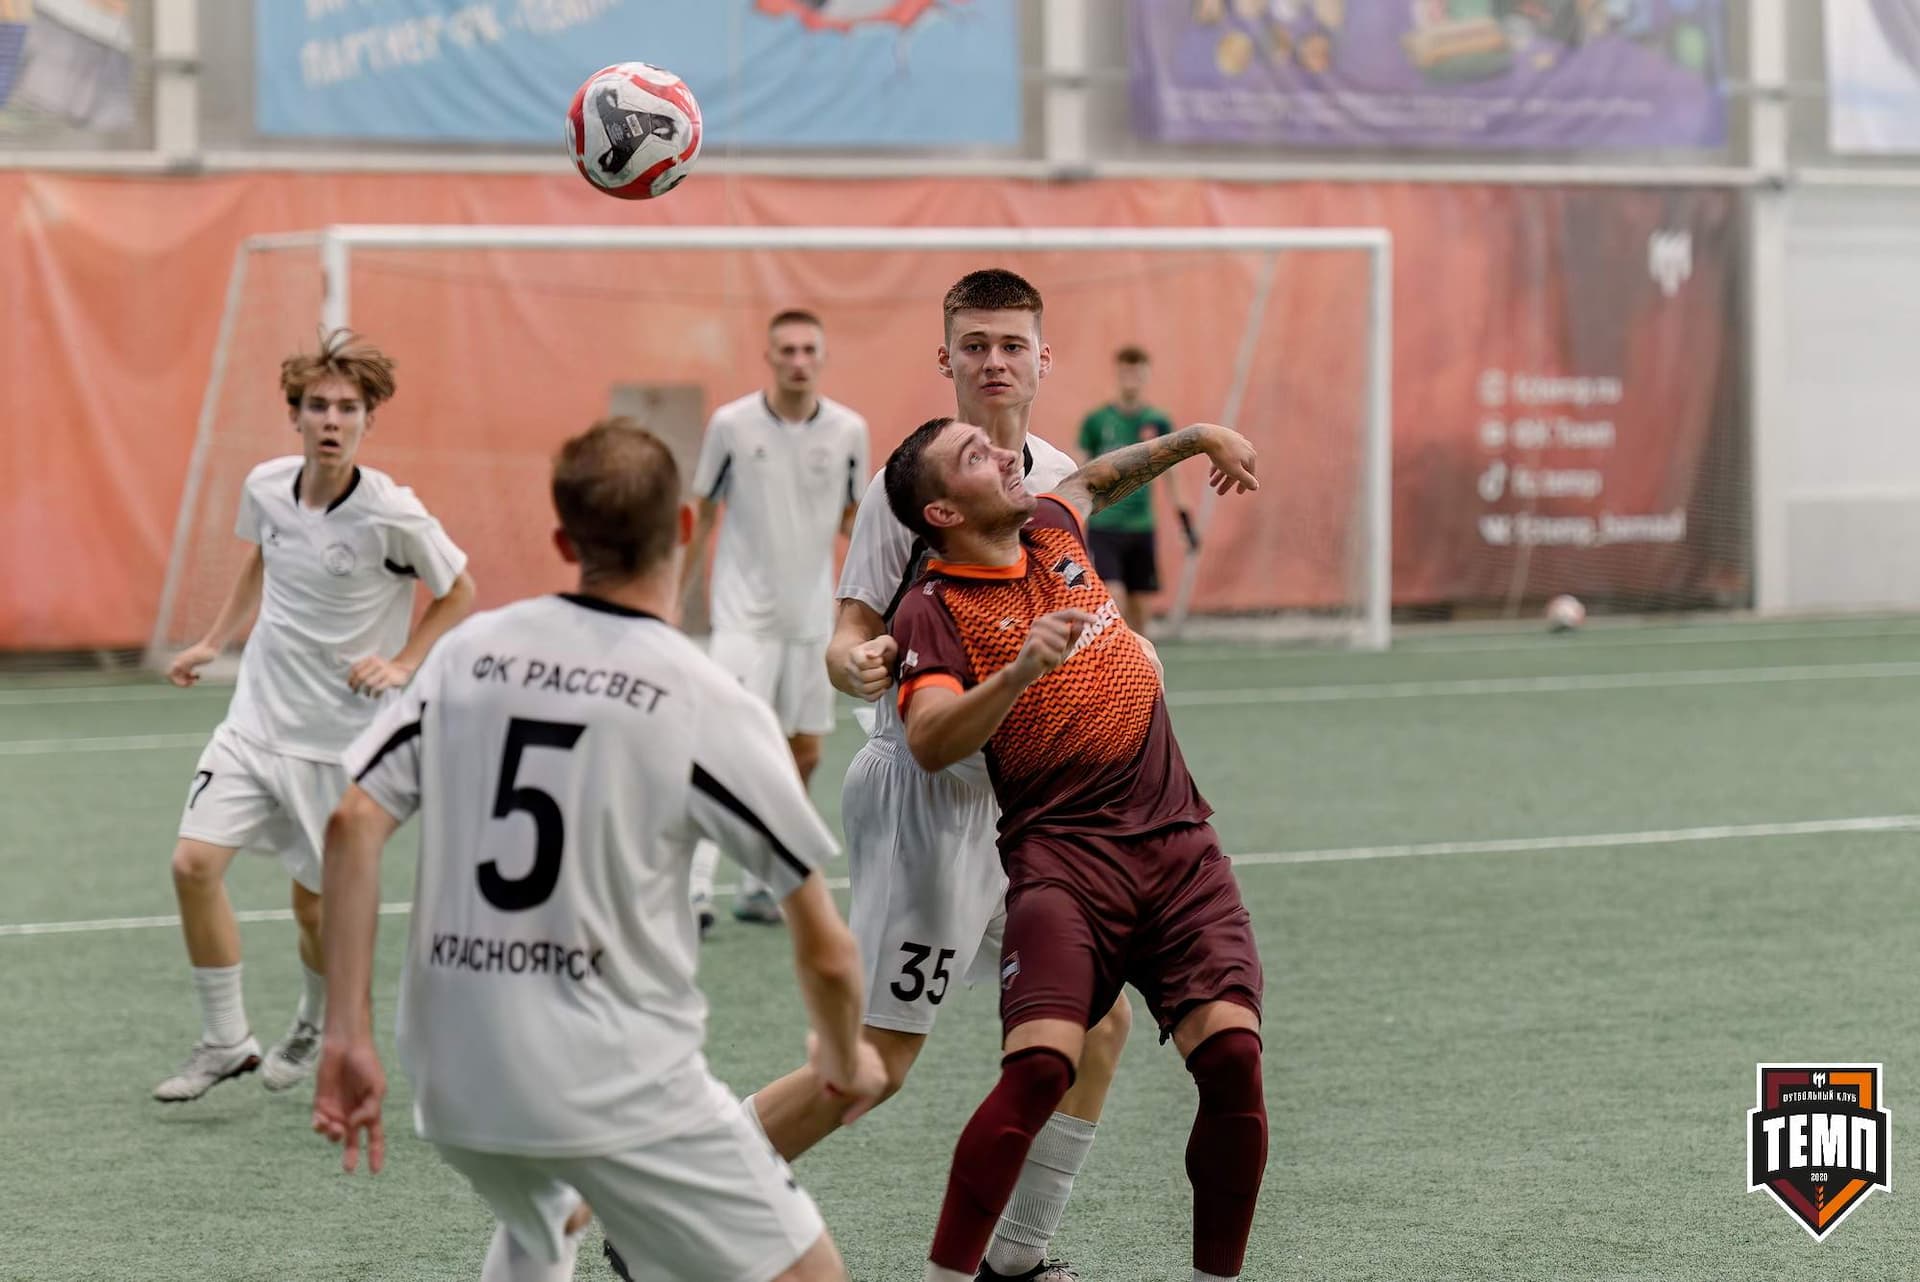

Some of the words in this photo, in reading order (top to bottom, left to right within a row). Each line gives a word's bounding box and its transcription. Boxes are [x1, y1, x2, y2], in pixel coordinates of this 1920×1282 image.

[473, 655, 515, 683] ФК
[523, 660, 669, 714] РАССВЕТ
[476, 716, 588, 914] 5
[890, 941, 956, 1005] 35
